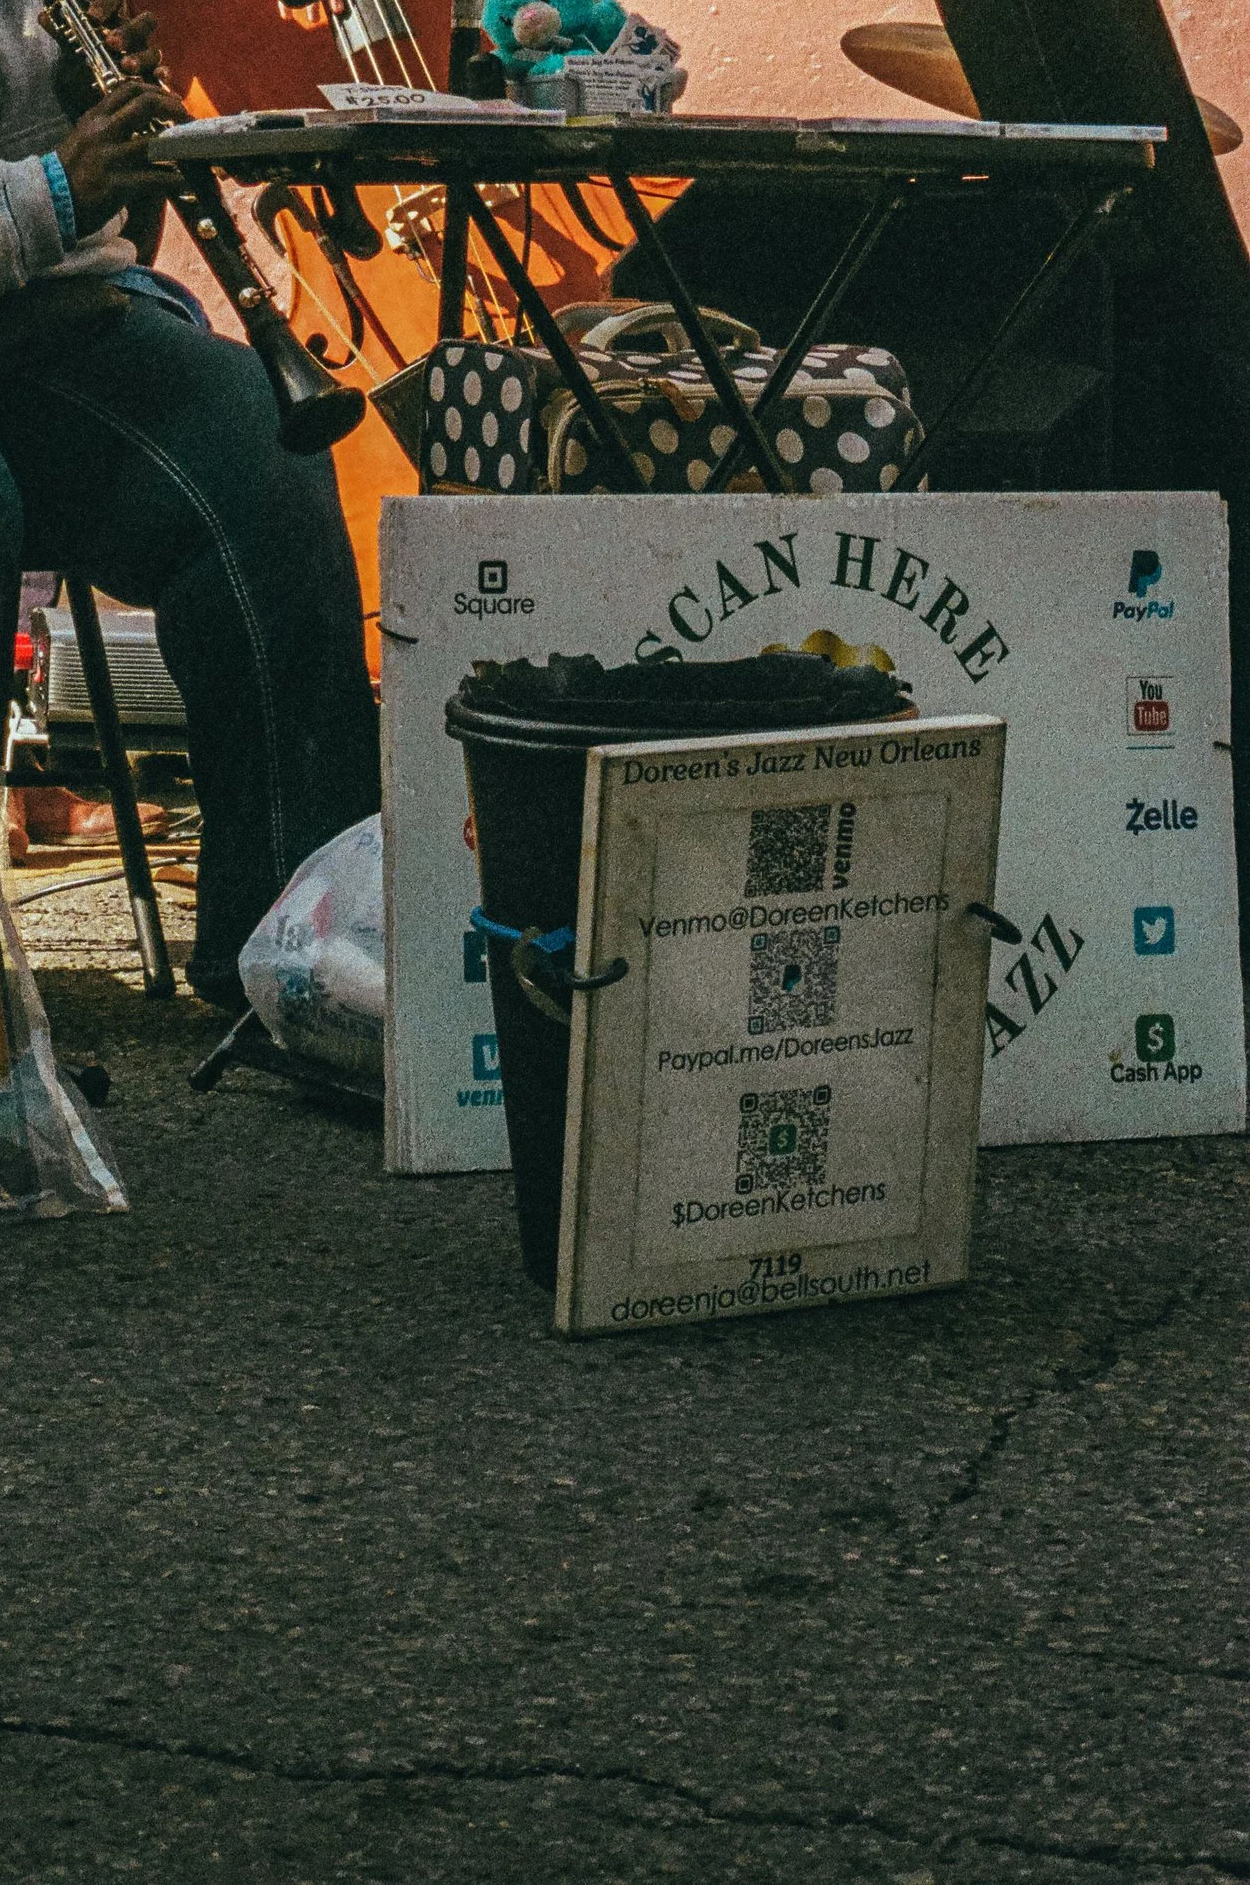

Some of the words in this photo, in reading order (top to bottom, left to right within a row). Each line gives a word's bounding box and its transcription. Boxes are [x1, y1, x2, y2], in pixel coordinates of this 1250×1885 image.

[454, 592, 535, 620] Square
[635, 533, 801, 664] SCAN
[830, 531, 1010, 684] HERE
[1112, 601, 1175, 622] PayPal
[1139, 680, 1163, 700] You
[1136, 706, 1168, 727] Tube
[623, 752, 739, 785] Doreen's
[745, 752, 806, 777] Jazz
[814, 745, 872, 771] New
[880, 738, 981, 765] Orleans
[1125, 797, 1198, 835] Zelle
[832, 802, 857, 890] venmo
[639, 890, 950, 939] Venmo@DoreenKetchens
[985, 912, 1085, 1059] AZZ
[658, 1027, 914, 1072] Paypal.me/DoreensJazz
[1110, 1061, 1158, 1083] Cash
[1163, 1062, 1202, 1084] App
[457, 1089, 504, 1108] ven
[671, 1182, 886, 1228] $DoreenKetchens
[750, 1254, 801, 1279] 7119
[611, 1259, 931, 1322] doreenja@bellsouth.net
